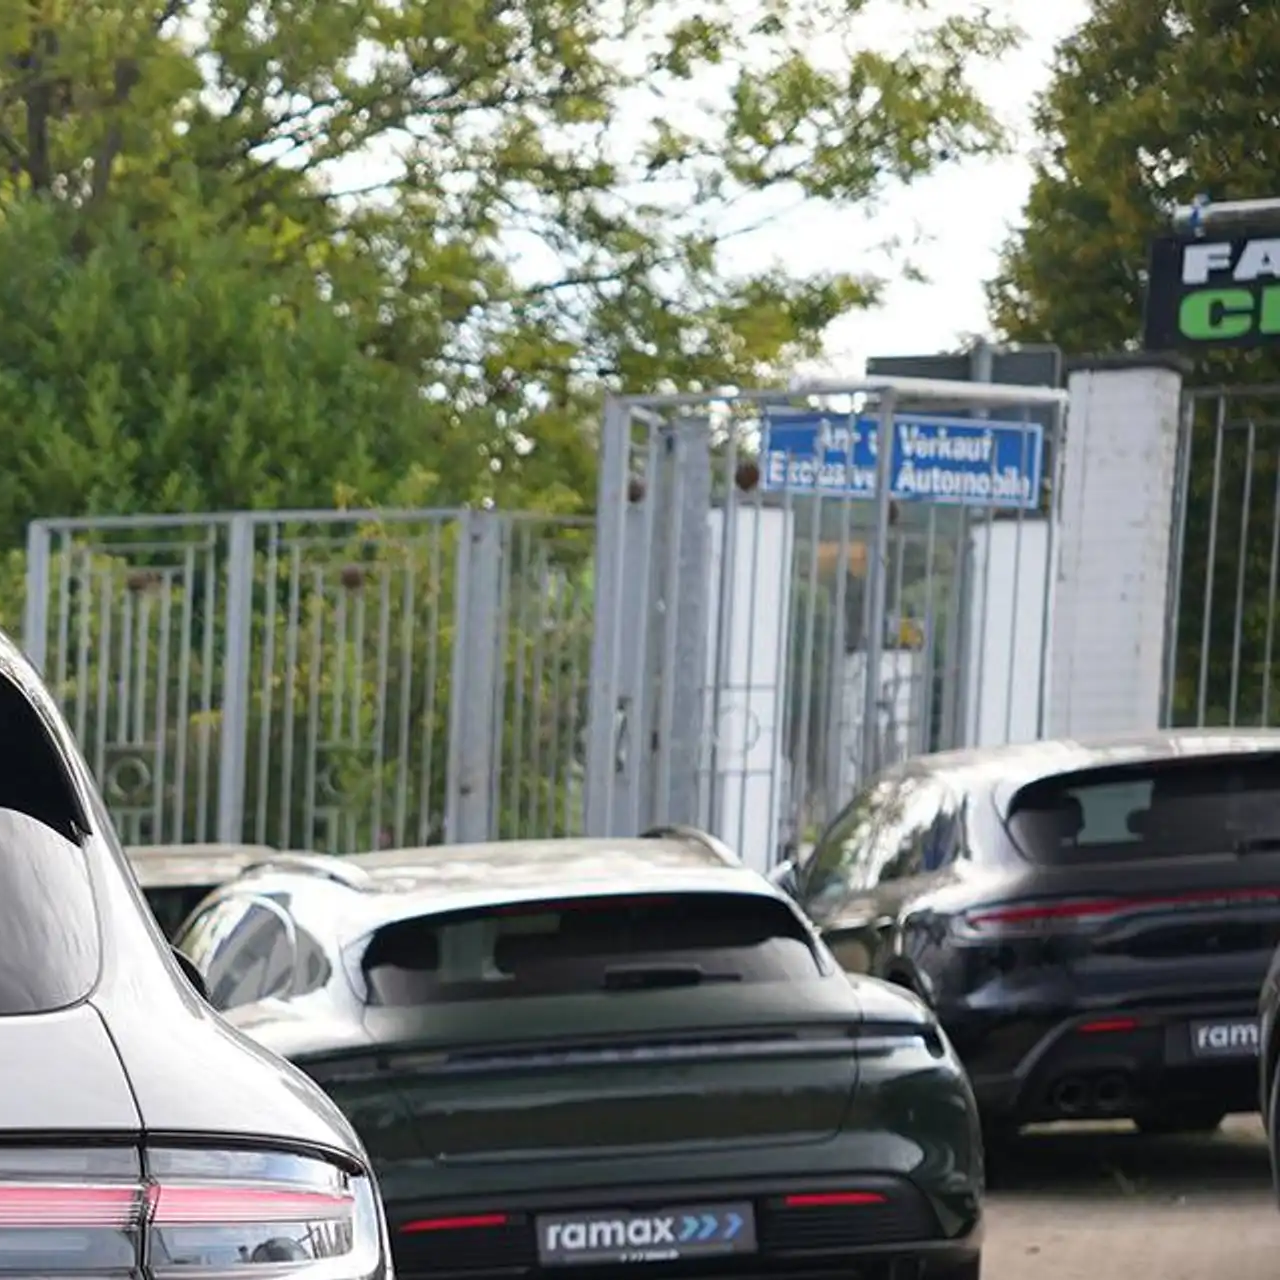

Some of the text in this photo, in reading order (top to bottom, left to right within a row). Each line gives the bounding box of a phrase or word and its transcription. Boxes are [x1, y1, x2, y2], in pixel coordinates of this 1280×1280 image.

[898, 424, 995, 463] Verkauf
[896, 460, 1030, 499] Automobile
[547, 1216, 676, 1250] ramax
